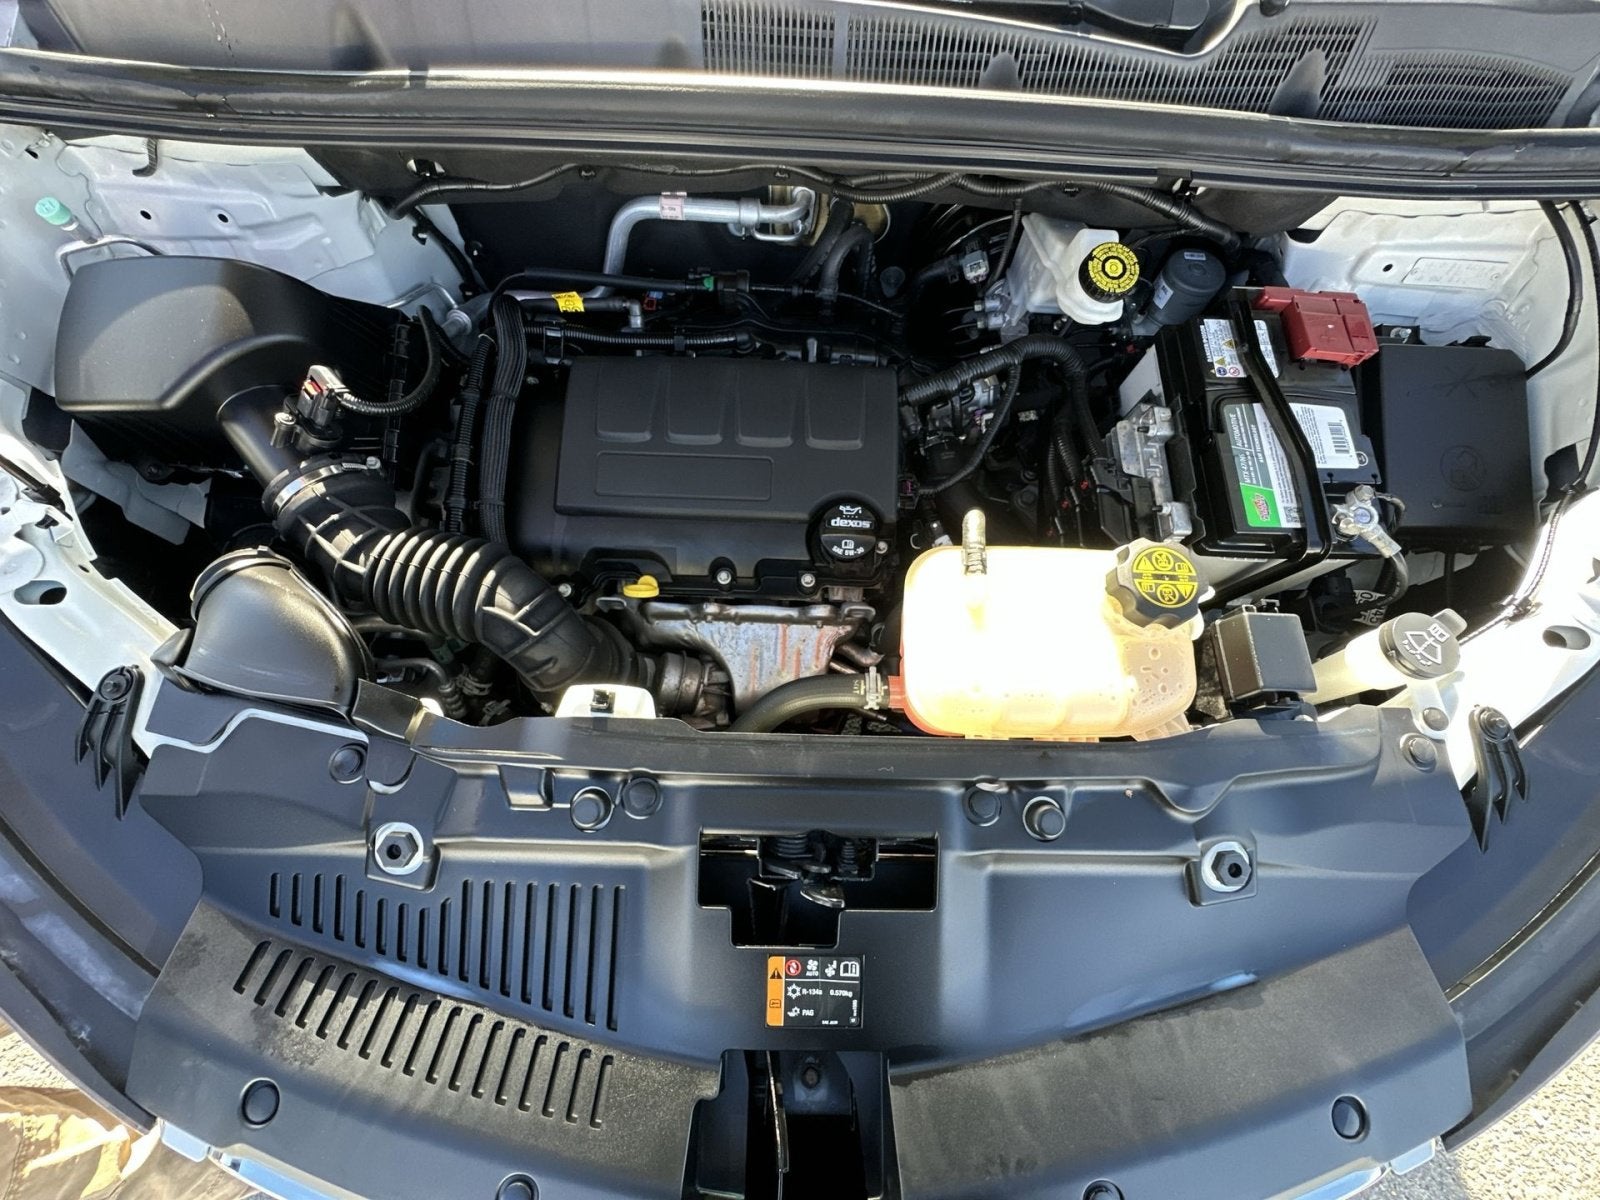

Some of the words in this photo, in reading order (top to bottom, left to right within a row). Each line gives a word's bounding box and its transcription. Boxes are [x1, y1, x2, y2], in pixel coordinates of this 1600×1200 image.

[1229, 413, 1243, 448] AUTOMOTIVE
[830, 517, 872, 529] dexos
[832, 545, 844, 556] SAE
[844, 546, 865, 556] 5W-30
[801, 988, 823, 996] R-134a
[829, 989, 853, 998] 0.570kg
[801, 1009, 815, 1017] PAG
